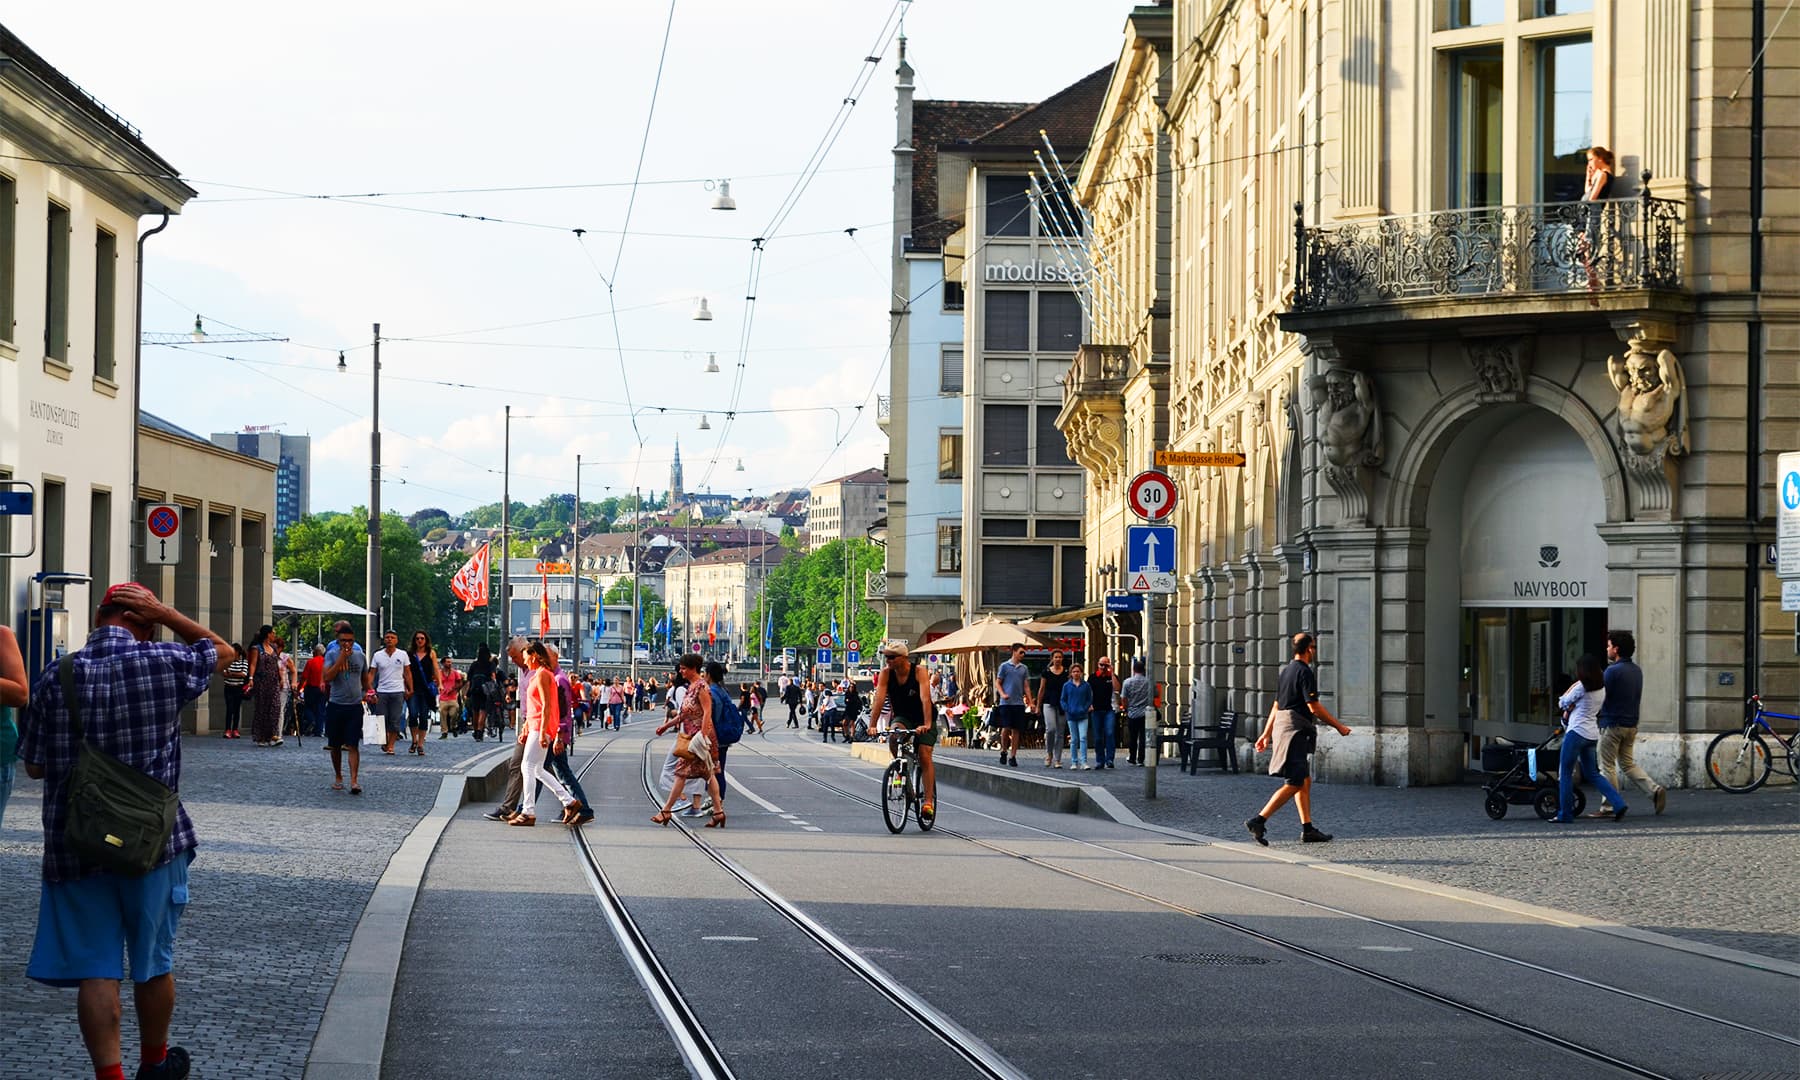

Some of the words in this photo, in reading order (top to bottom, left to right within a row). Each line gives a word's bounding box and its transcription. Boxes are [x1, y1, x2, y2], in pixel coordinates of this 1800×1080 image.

[985, 258, 1084, 282] modissa
[29, 399, 81, 430] KANTONSPOLIZEI
[1168, 453, 1212, 466] Marktgasse
[1214, 454, 1235, 465] Hotel
[1144, 487, 1161, 503] 30
[1513, 581, 1588, 597] NAVYBOOT
